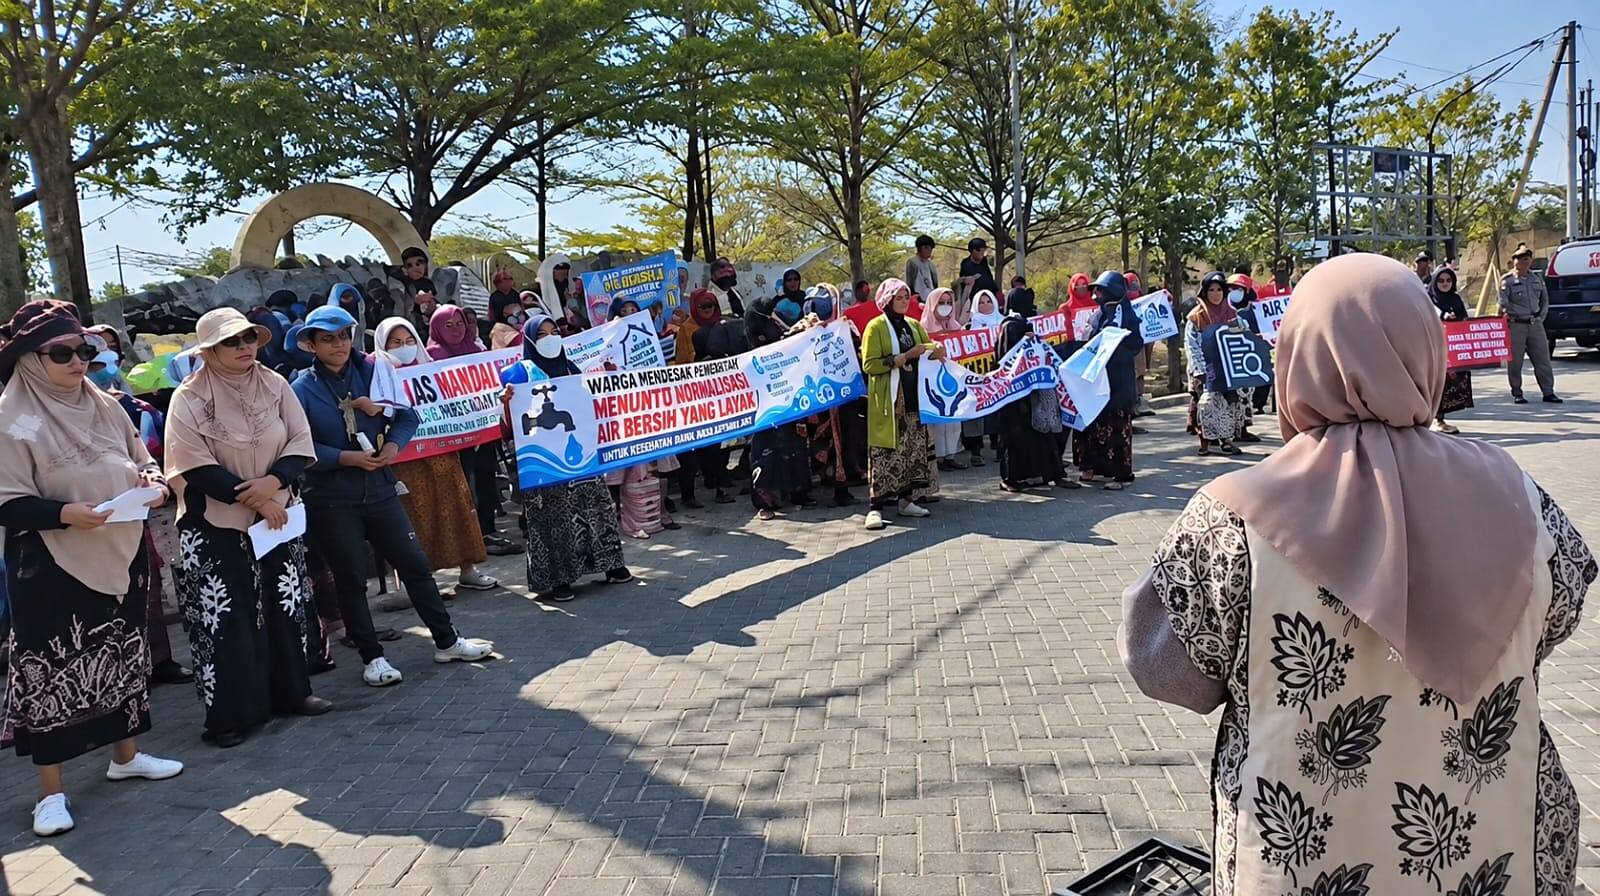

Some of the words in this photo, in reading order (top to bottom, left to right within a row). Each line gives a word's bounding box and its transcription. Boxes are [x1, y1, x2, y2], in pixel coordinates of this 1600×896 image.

[587, 373, 638, 394] WARGA
[638, 366, 693, 387] MENDESAK
[675, 372, 750, 404] NORMALISASI
[597, 420, 621, 444] AIR
[623, 409, 677, 438] BERSIH
[680, 401, 716, 425] YANG
[717, 391, 756, 417] LAYAK
[602, 446, 629, 462] UNTUK
